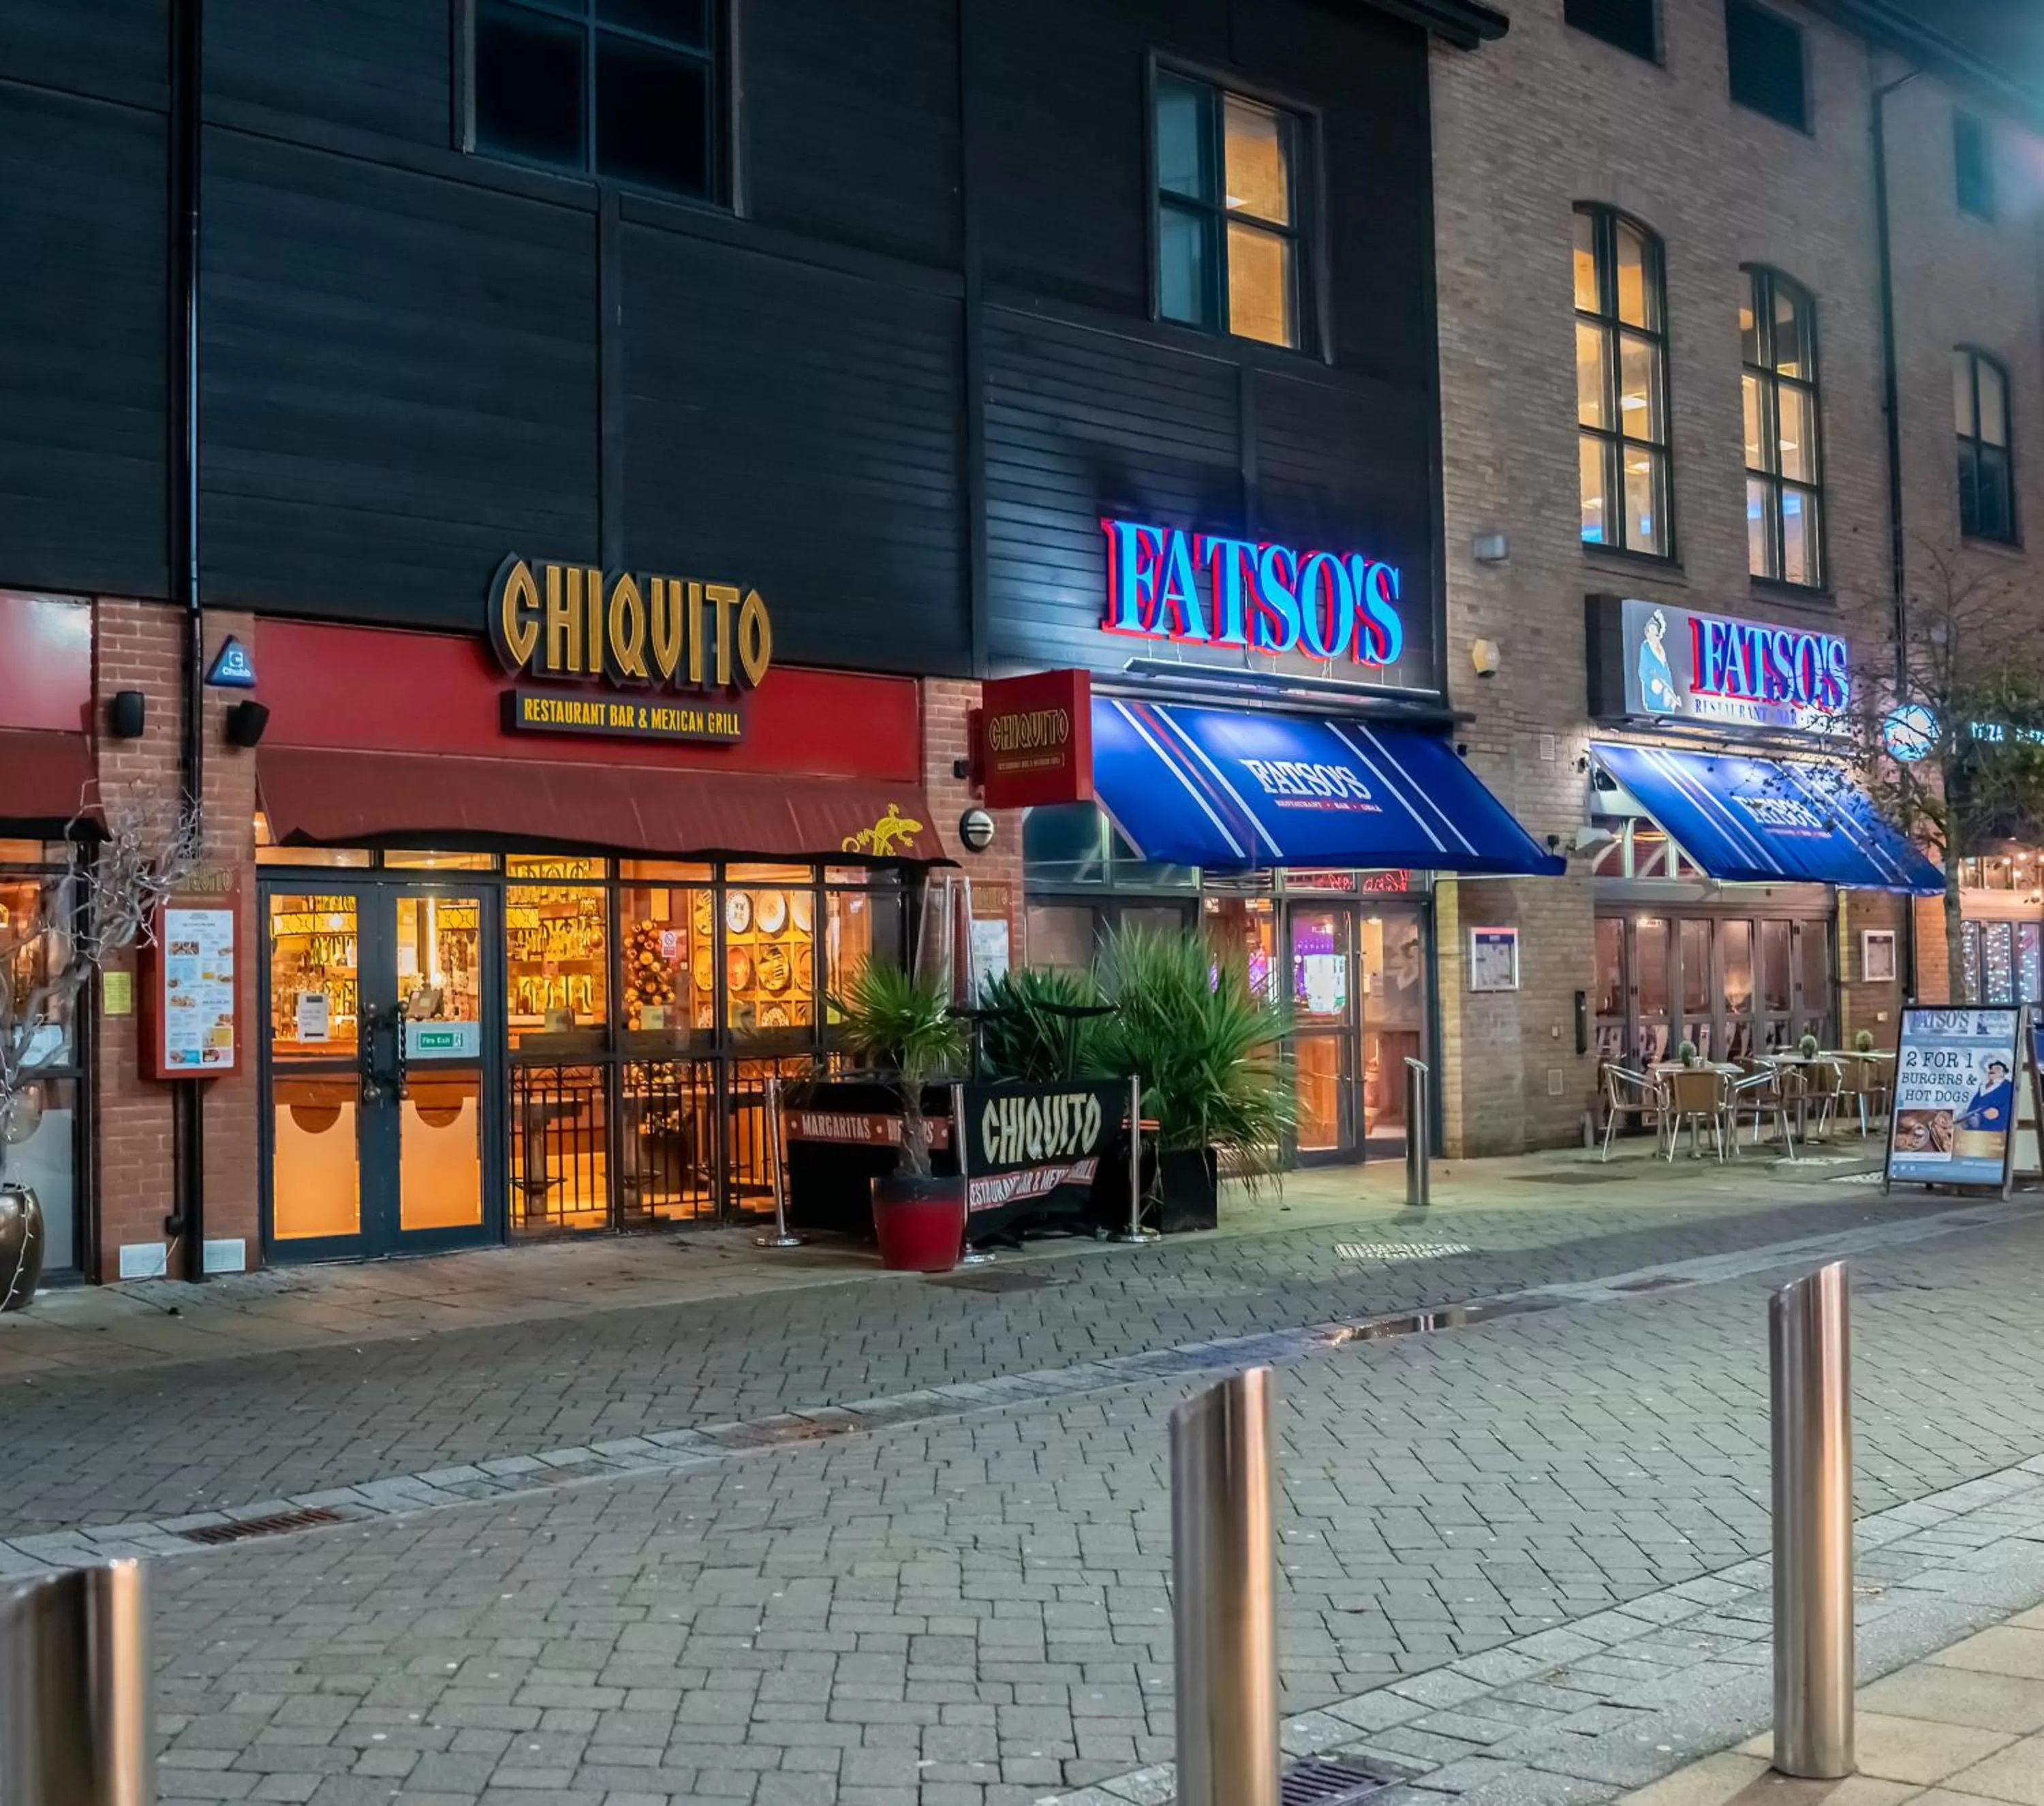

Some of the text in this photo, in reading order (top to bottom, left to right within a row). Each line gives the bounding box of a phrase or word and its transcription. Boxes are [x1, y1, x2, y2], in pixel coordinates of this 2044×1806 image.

[1102, 518, 1404, 666] FATSO'S
[499, 557, 773, 688] CHIQUITO
[1689, 617, 1851, 716] FATSO'S
[524, 697, 741, 736] RESTAURANT BAR & MEXICAN GRILL
[989, 708, 1069, 752] CHIQUITO
[1238, 758, 1372, 800] FATSO'S
[1902, 1072, 1977, 1086] BURGERS &
[1906, 1051, 1974, 1069] 2 FOR 1
[1904, 1090, 1970, 1103] HOT DOGS
[801, 1114, 871, 1140] MARGARITAS
[982, 1092, 1102, 1165] CHIQUITO
